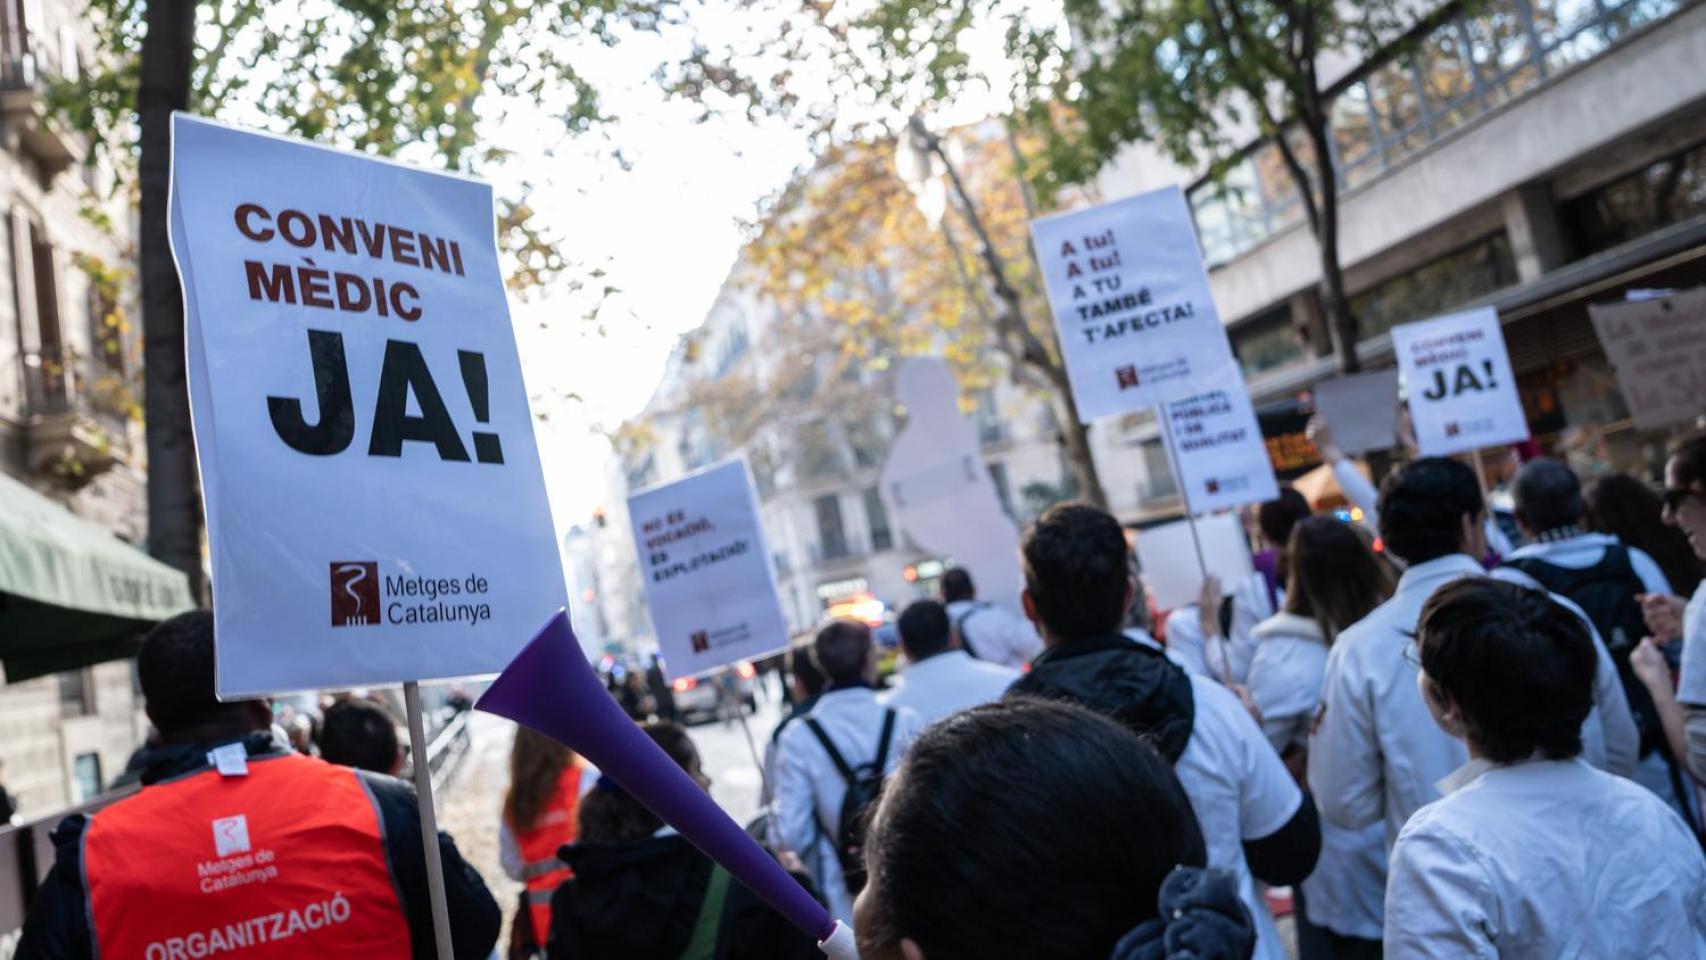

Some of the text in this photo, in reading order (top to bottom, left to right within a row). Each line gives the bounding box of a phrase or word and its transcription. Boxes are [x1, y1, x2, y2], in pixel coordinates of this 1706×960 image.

[234, 203, 465, 277] CONVENI
[1062, 229, 1114, 257] A tu!
[1067, 250, 1121, 279] A tu!
[244, 257, 422, 322] MÈDIC
[1073, 275, 1121, 299] A TU
[1077, 288, 1152, 321] TAMBÉ
[1083, 302, 1194, 344] T'AFECTA!
[1423, 358, 1497, 400] JA!
[266, 328, 505, 465] JA!
[386, 573, 488, 601] Metges de
[388, 601, 491, 626] Catalunya
[197, 849, 275, 877] Metges de
[201, 865, 278, 893] Catalunya
[145, 891, 350, 960] ORGANITZACIÓ
